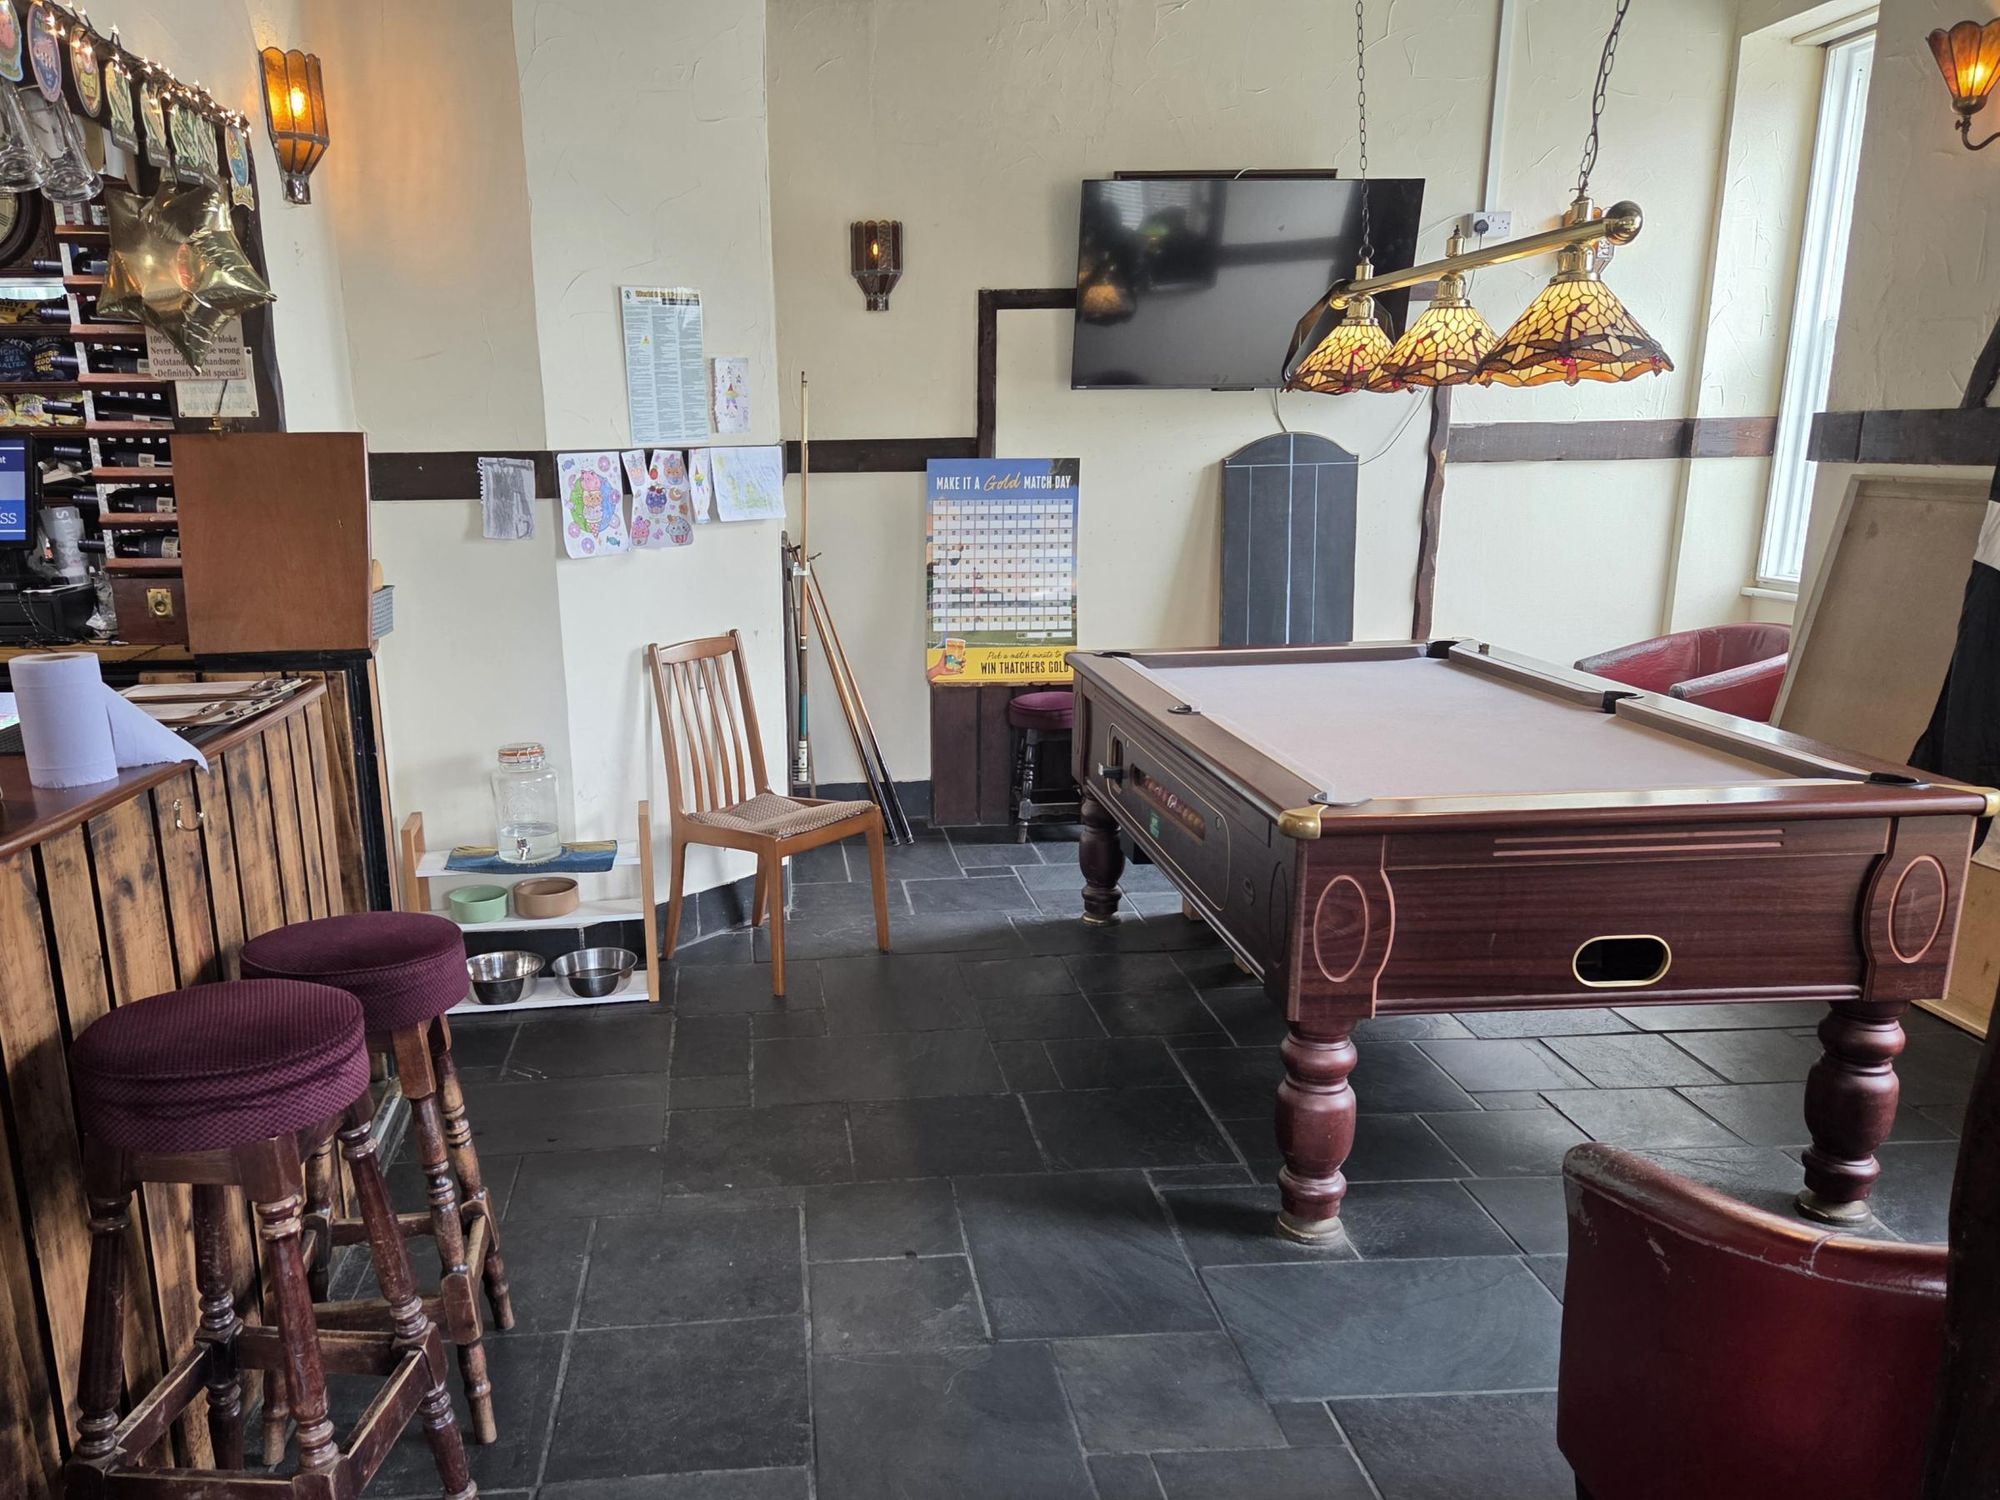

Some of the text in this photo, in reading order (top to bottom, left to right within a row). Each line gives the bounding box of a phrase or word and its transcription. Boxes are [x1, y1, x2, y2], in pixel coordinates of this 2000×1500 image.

[218, 334, 237, 344] bloke
[150, 347, 172, 355] Never
[219, 347, 241, 356] wrong
[936, 472, 1072, 492] MAKE IT A Gold MATCH DAY
[987, 651, 1002, 660] Pick
[981, 662, 996, 675] WIN
[999, 661, 1046, 674] THATCHERS
